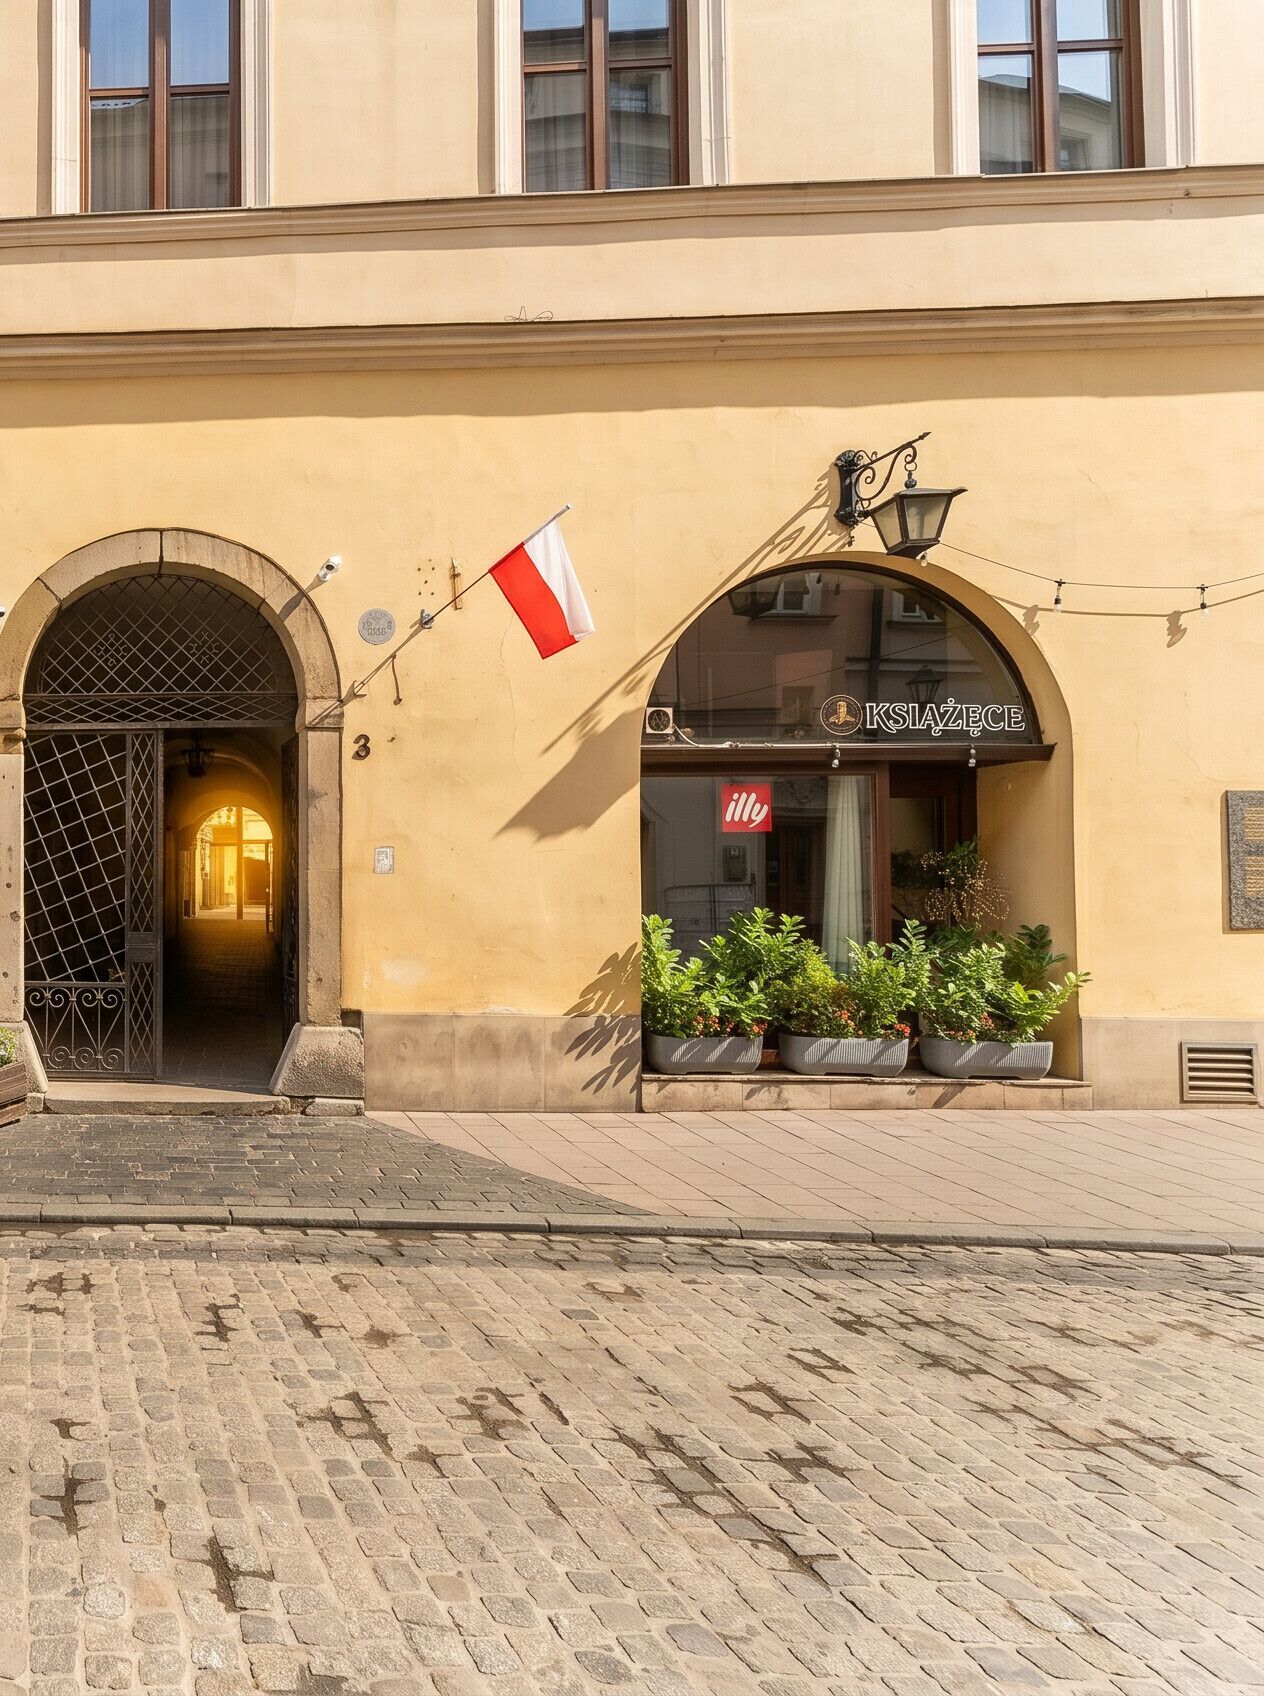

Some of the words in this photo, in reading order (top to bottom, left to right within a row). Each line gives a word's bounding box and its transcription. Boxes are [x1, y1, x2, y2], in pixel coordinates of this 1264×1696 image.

[866, 698, 1025, 737] KSIĄŻĘCE
[352, 734, 370, 760] 3
[726, 792, 768, 827] illy
